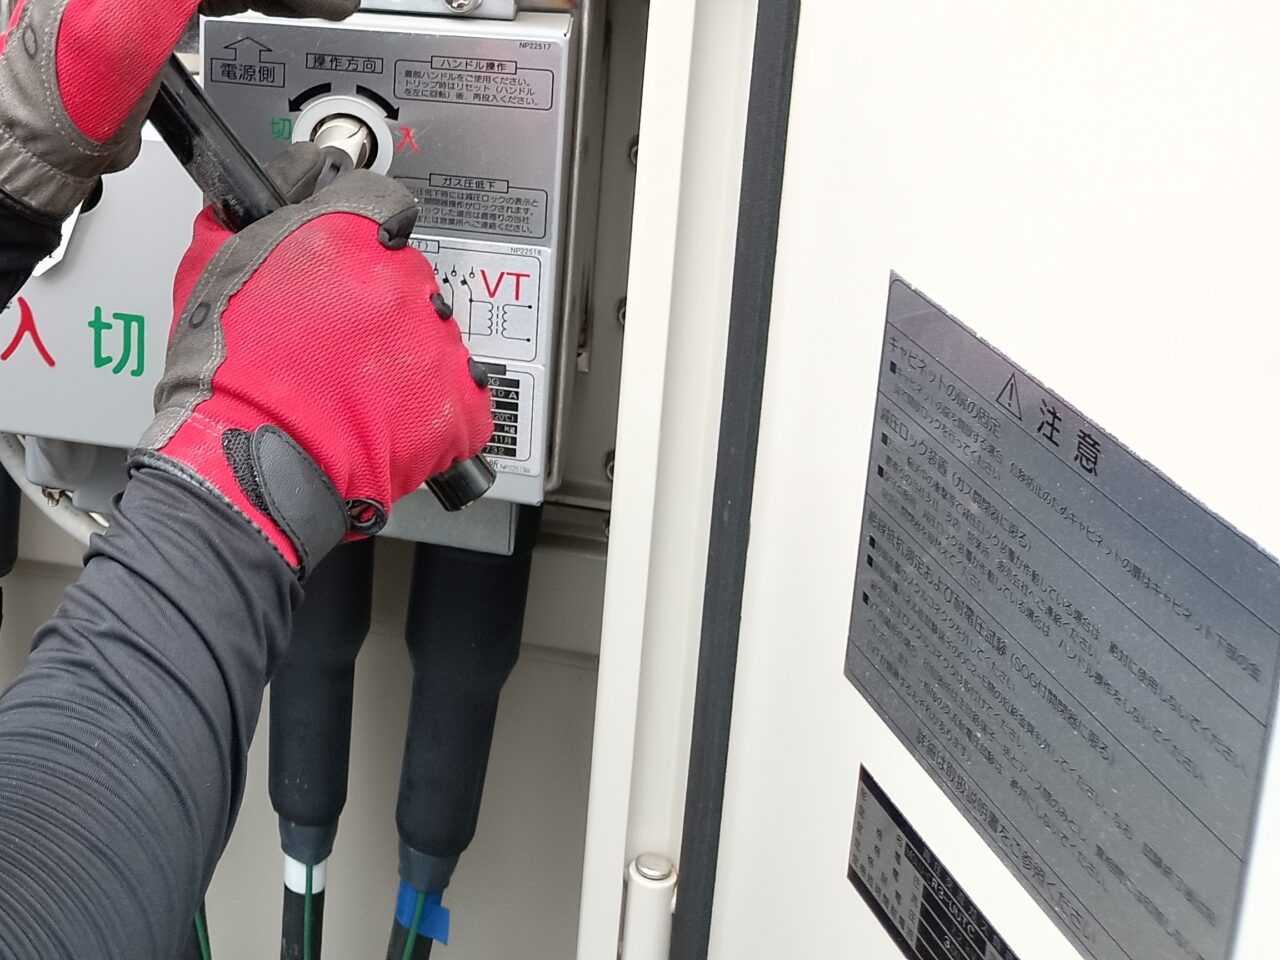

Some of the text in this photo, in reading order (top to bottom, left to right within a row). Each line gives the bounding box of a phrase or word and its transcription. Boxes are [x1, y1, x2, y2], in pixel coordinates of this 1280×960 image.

[519, 42, 552, 51] NP22517
[220, 63, 276, 83] 電源側
[313, 54, 377, 73] 操作方向
[440, 58, 508, 72] ハンドル操作
[271, 117, 292, 141] 切
[396, 126, 421, 153] 入
[441, 176, 497, 190] ガス圧低下
[510, 247, 542, 257] NP22518
[480, 269, 531, 301] VT
[0, 296, 146, 378] 入 切
[508, 391, 518, 399] A
[504, 426, 516, 434] kg
[1037, 397, 1099, 478] 注意
